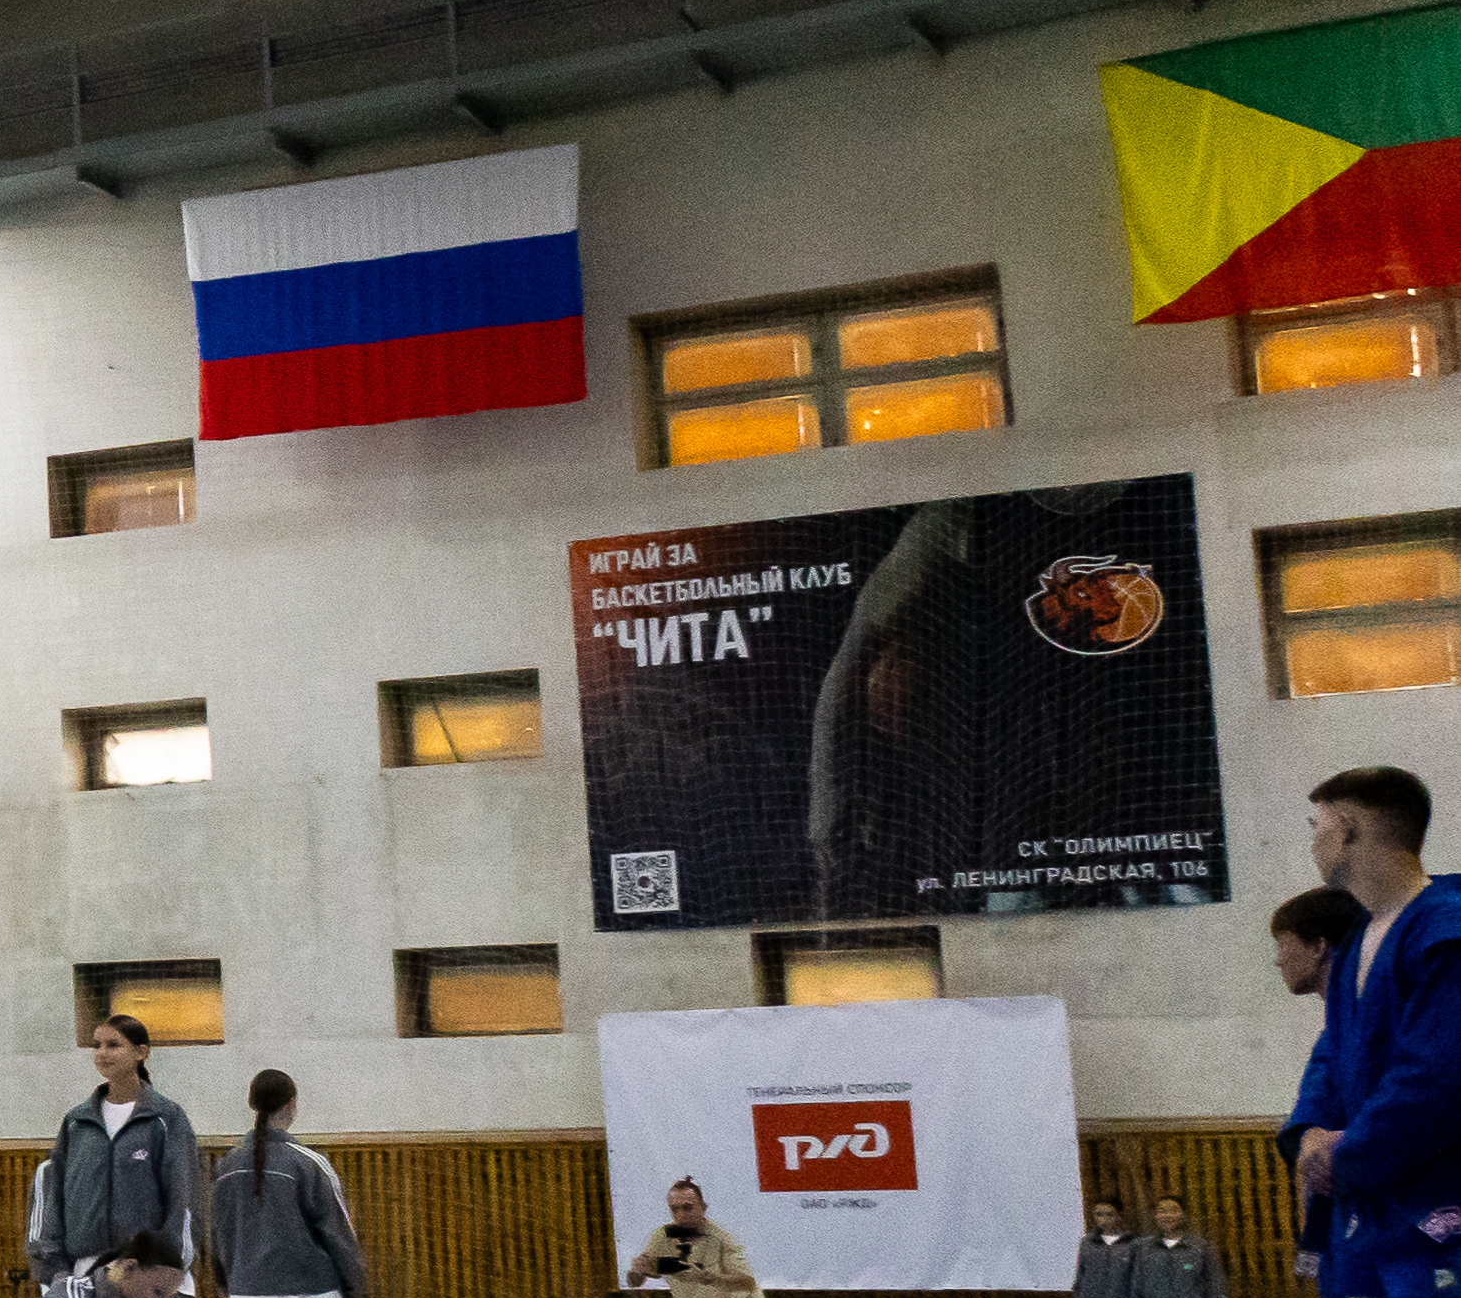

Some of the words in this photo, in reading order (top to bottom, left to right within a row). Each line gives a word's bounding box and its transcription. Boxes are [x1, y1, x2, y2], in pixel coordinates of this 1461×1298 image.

[589, 543, 661, 575] ИГРАЙ
[667, 543, 698, 567] ЗА
[591, 565, 784, 610] БАСКЕТБОЛЬНЫЙ
[790, 562, 852, 590] КЛУБ
[1018, 840, 1049, 858] СК
[1170, 860, 1209, 878] 106
